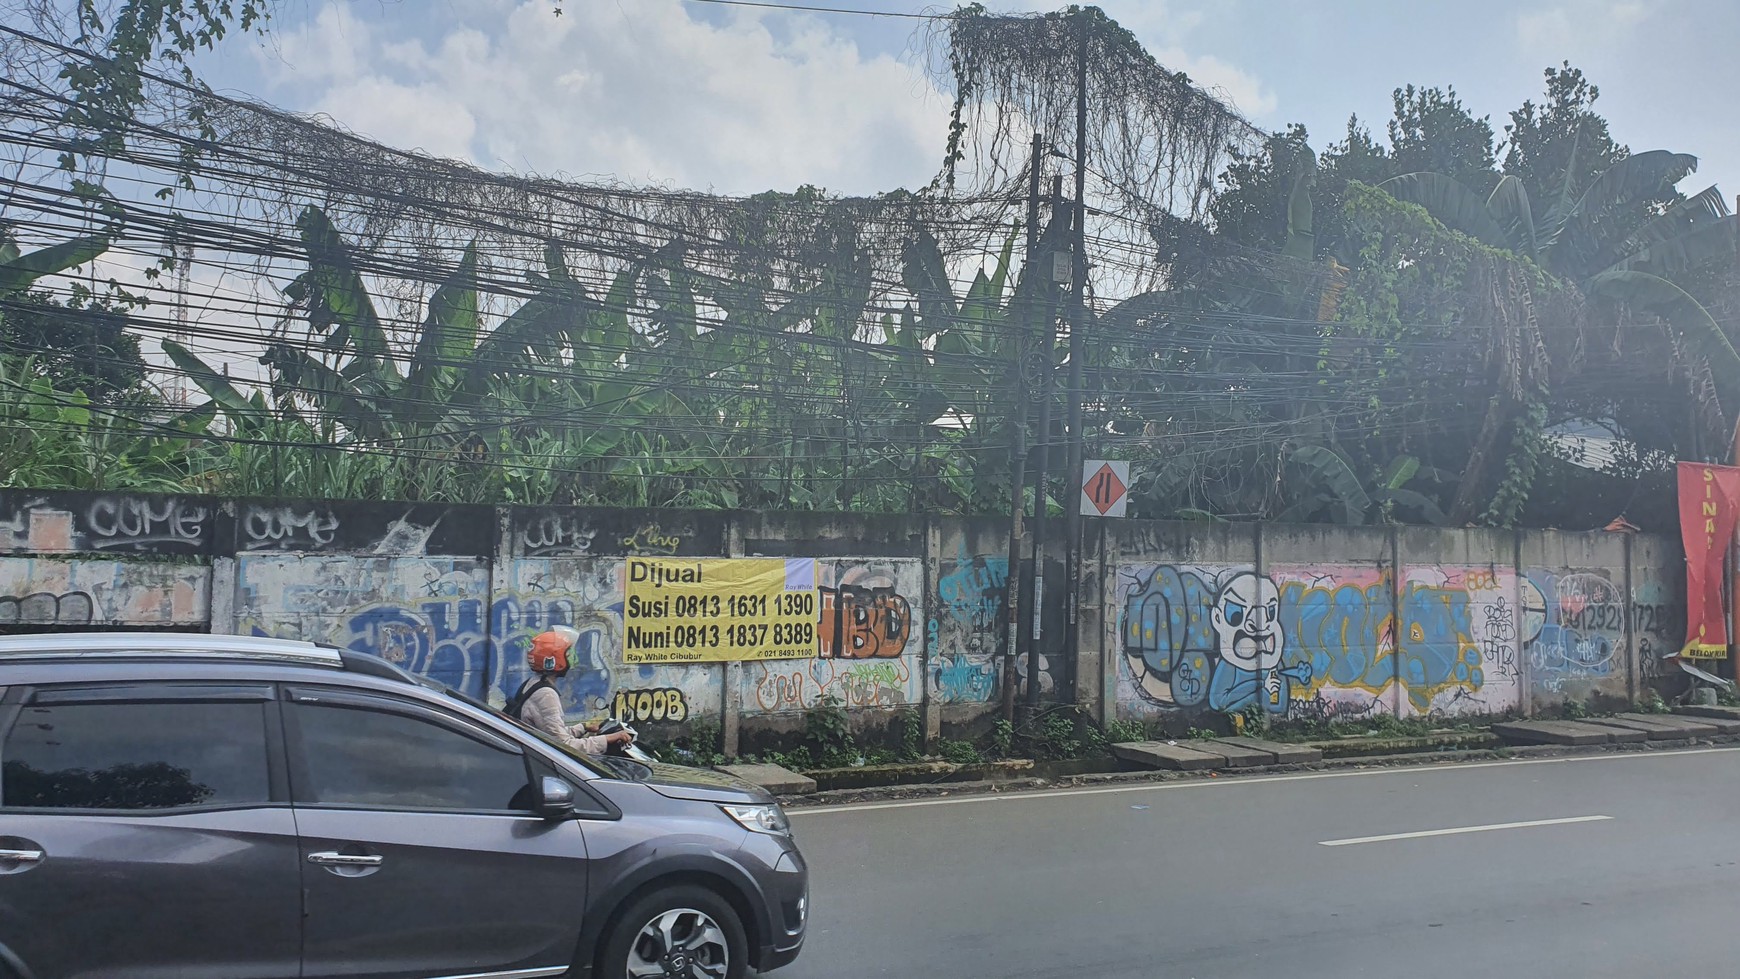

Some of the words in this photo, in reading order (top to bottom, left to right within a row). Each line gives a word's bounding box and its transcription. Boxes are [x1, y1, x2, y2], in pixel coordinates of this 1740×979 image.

[630, 561, 702, 588] Dijual
[628, 595, 669, 618] Susi
[675, 595, 720, 617] 0813
[727, 594, 767, 617] 1631
[774, 593, 813, 616] 1390
[627, 626, 671, 649] Nuni
[674, 625, 720, 647] 0813
[726, 624, 768, 647] 1837
[773, 622, 813, 645] 8389
[627, 653, 643, 662] Ray
[645, 653, 668, 661] White
[670, 652, 702, 660] Cibubur
[778, 649, 795, 657] 8493
